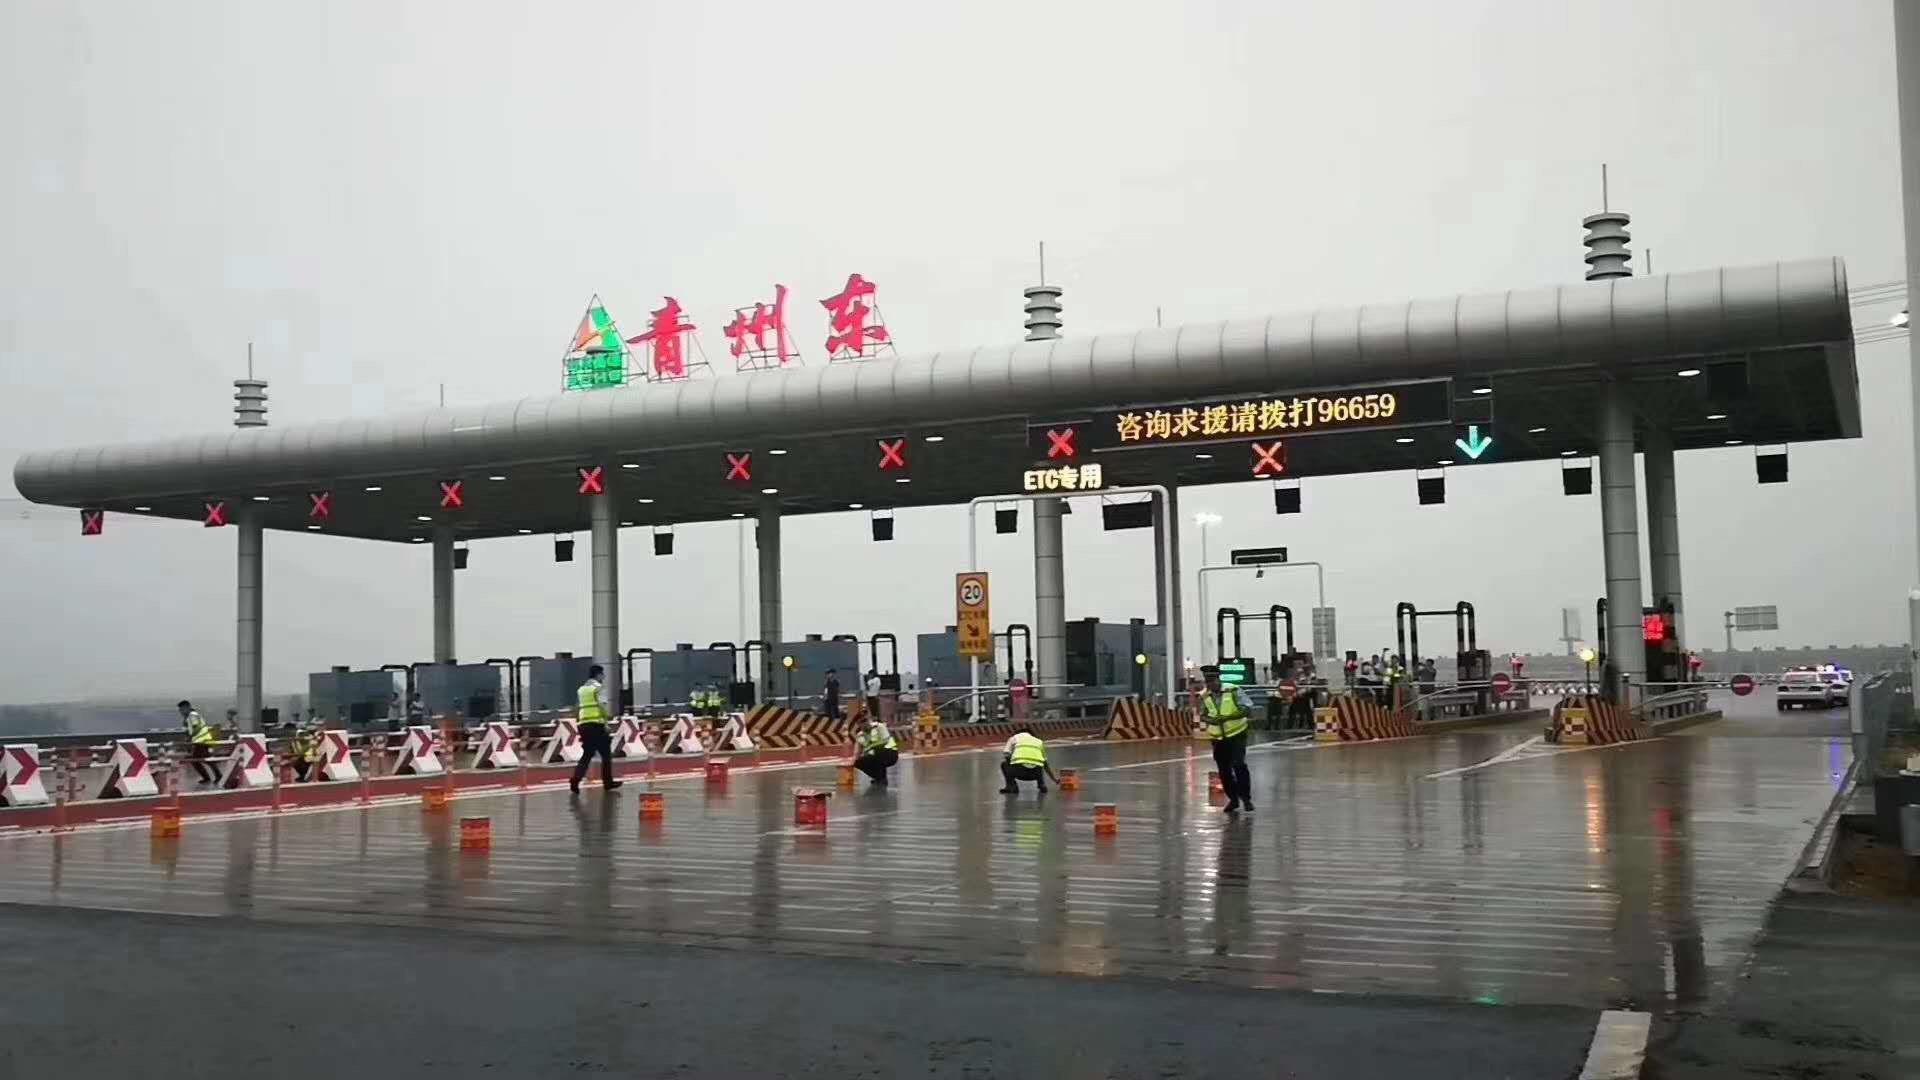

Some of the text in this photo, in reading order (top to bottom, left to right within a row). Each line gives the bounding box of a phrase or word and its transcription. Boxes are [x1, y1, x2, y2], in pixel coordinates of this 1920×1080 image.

[1117, 393, 1396, 441] 咨询求援请拨打96659
[1024, 463, 1102, 490] ETC专用
[964, 584, 981, 600] 20
